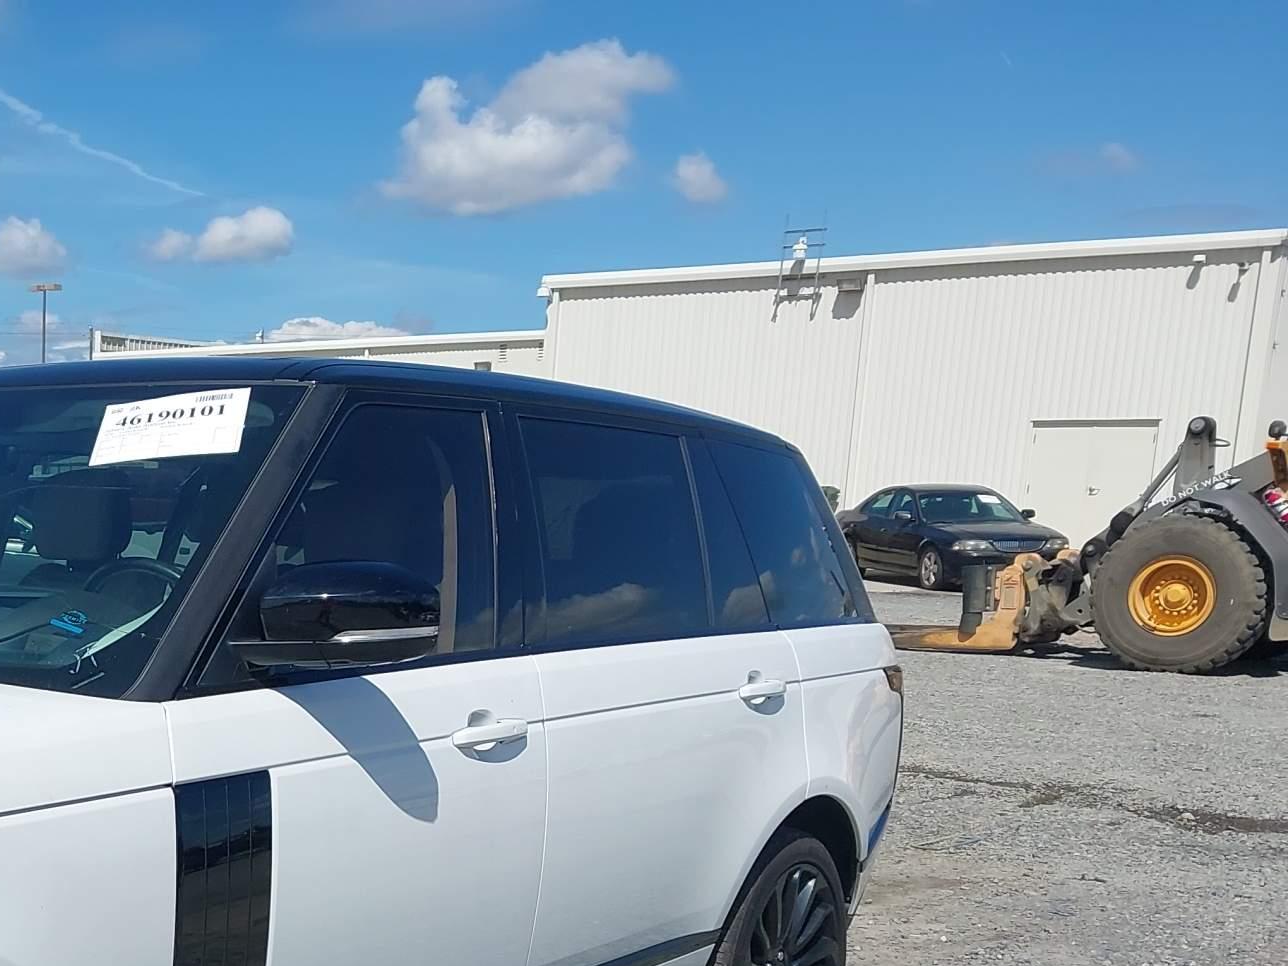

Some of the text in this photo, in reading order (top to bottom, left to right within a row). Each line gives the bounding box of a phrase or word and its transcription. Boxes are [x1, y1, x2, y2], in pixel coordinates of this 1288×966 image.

[116, 404, 226, 427] 46190101
[1161, 470, 1232, 507] DO NOT WALK
